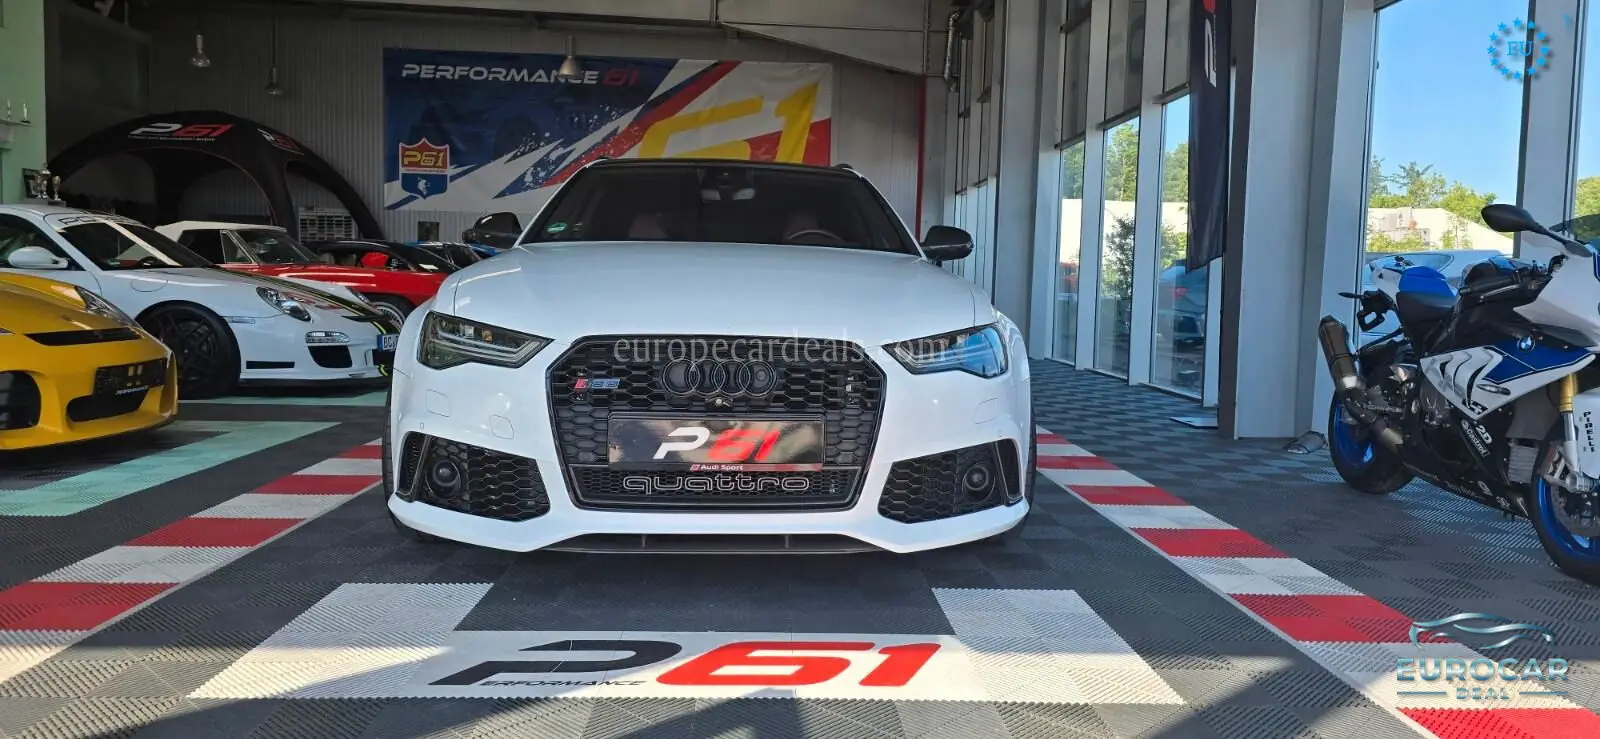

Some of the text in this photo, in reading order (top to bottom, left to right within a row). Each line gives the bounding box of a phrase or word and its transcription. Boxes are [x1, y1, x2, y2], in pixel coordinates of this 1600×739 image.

[603, 68, 640, 85] 61
[128, 122, 235, 137] P61
[403, 150, 445, 167] P61
[653, 426, 781, 461] P61
[1465, 427, 1491, 459] Castrol
[1583, 411, 1596, 453] PIRELLI
[721, 464, 743, 473] Sport
[622, 473, 810, 496] quattro
[427, 639, 942, 687] P61
